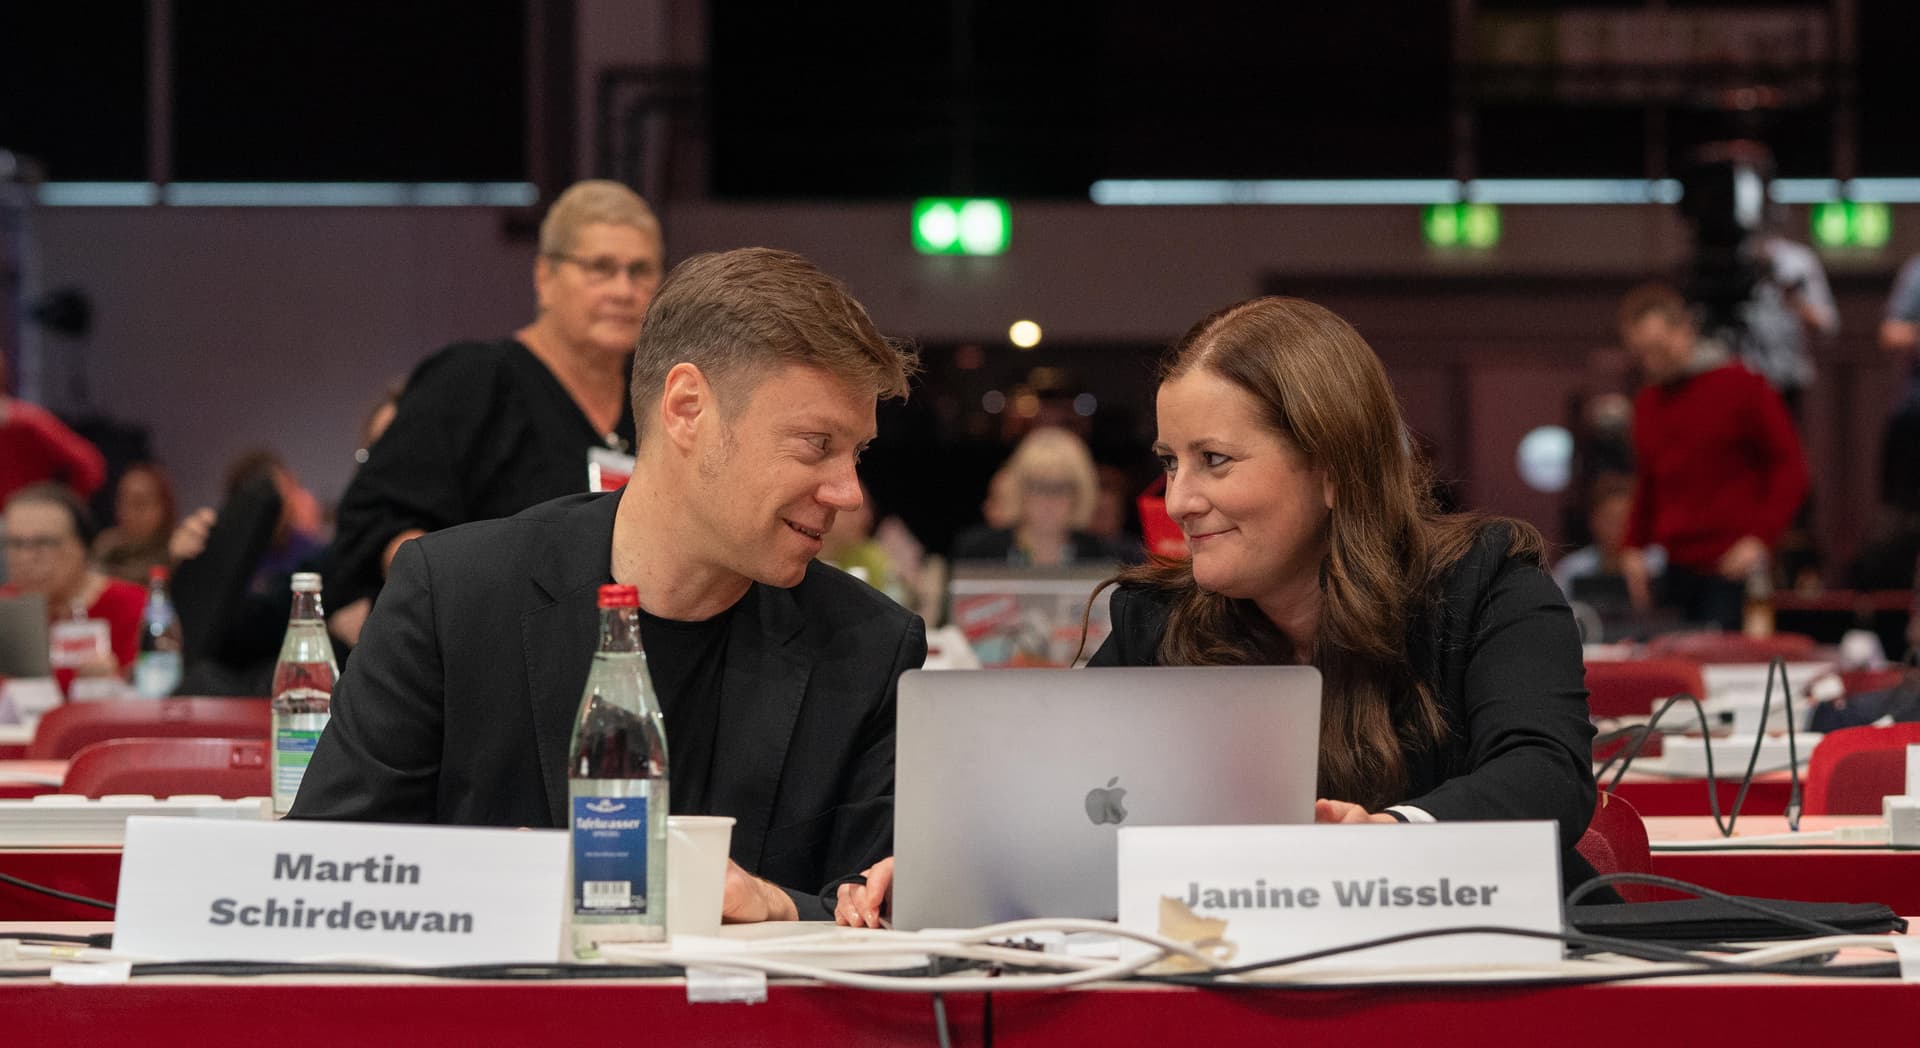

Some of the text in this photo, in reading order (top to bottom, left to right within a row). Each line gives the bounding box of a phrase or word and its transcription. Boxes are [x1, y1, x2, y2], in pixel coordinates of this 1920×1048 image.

[273, 853, 420, 884] Martin
[1178, 878, 1498, 909] Janine Wissler
[209, 898, 474, 933] Schirdewan
